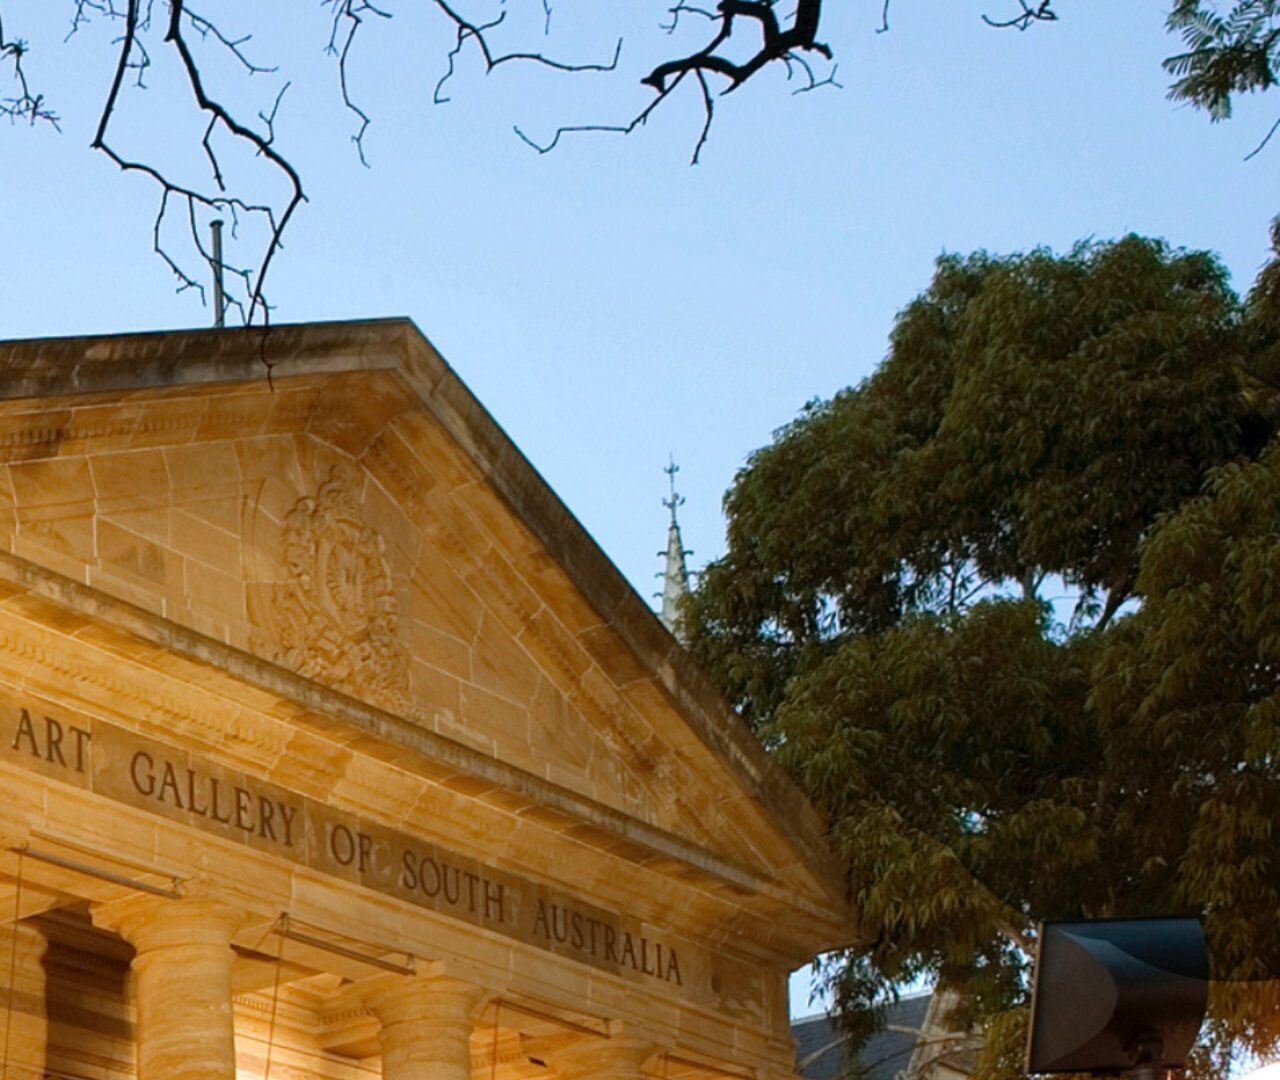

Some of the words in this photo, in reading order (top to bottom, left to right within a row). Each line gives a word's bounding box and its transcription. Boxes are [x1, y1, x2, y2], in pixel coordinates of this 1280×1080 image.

[11, 708, 92, 773] ART
[130, 751, 297, 847] GALLERY
[331, 824, 372, 873] OF
[402, 850, 505, 923] SOUTH
[532, 899, 683, 986] AUSTRALIA
